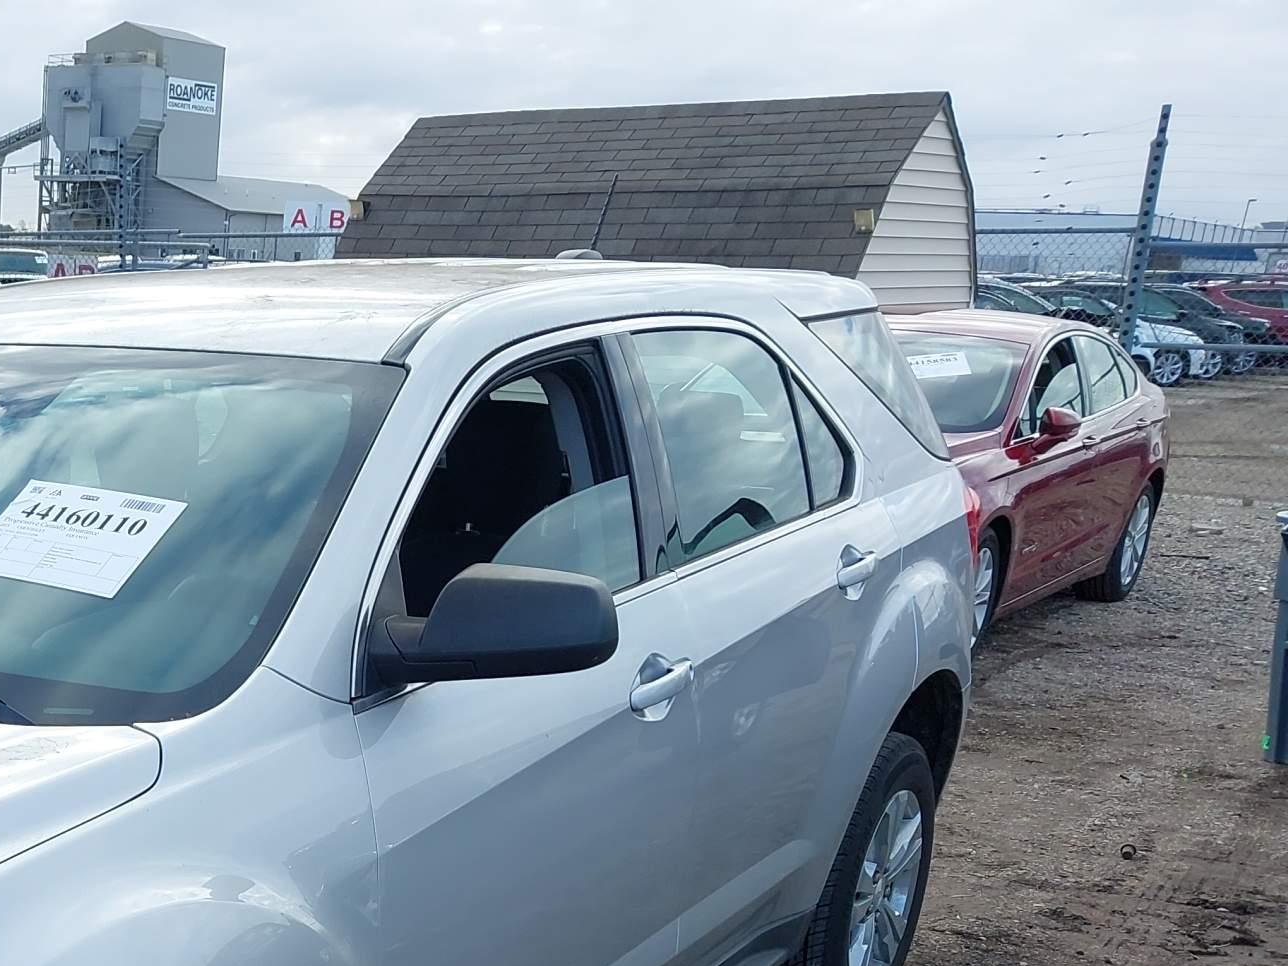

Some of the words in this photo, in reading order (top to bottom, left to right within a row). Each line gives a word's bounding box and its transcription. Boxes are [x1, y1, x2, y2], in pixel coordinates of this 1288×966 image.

[169, 83, 216, 101] ROANOKE
[290, 208, 308, 229] A
[328, 209, 346, 229] B
[21, 502, 148, 536] 44160110
